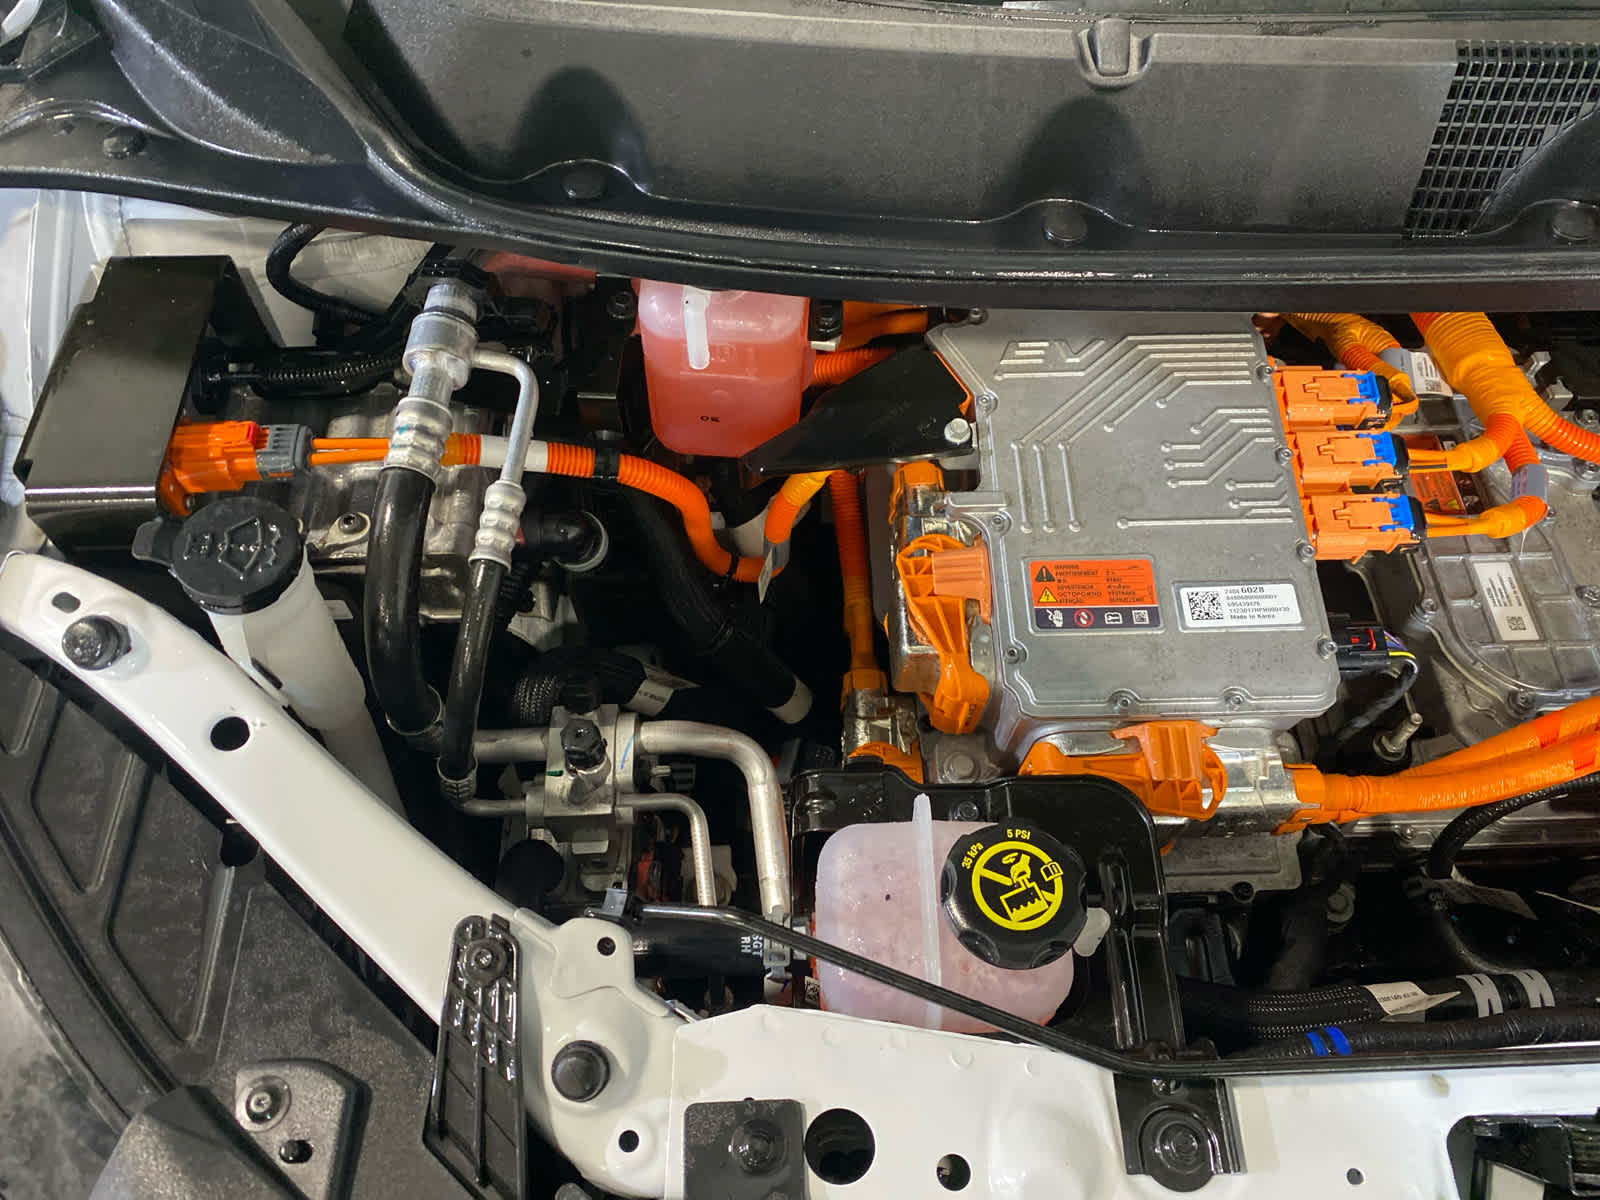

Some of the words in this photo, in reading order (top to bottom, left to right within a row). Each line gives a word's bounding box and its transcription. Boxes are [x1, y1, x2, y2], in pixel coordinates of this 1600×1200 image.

[1006, 829, 1014, 838] 5
[1015, 829, 1031, 840] PSI
[961, 857, 973, 869] 35
[967, 842, 984, 858] kPa
[740, 936, 751, 953] RH
